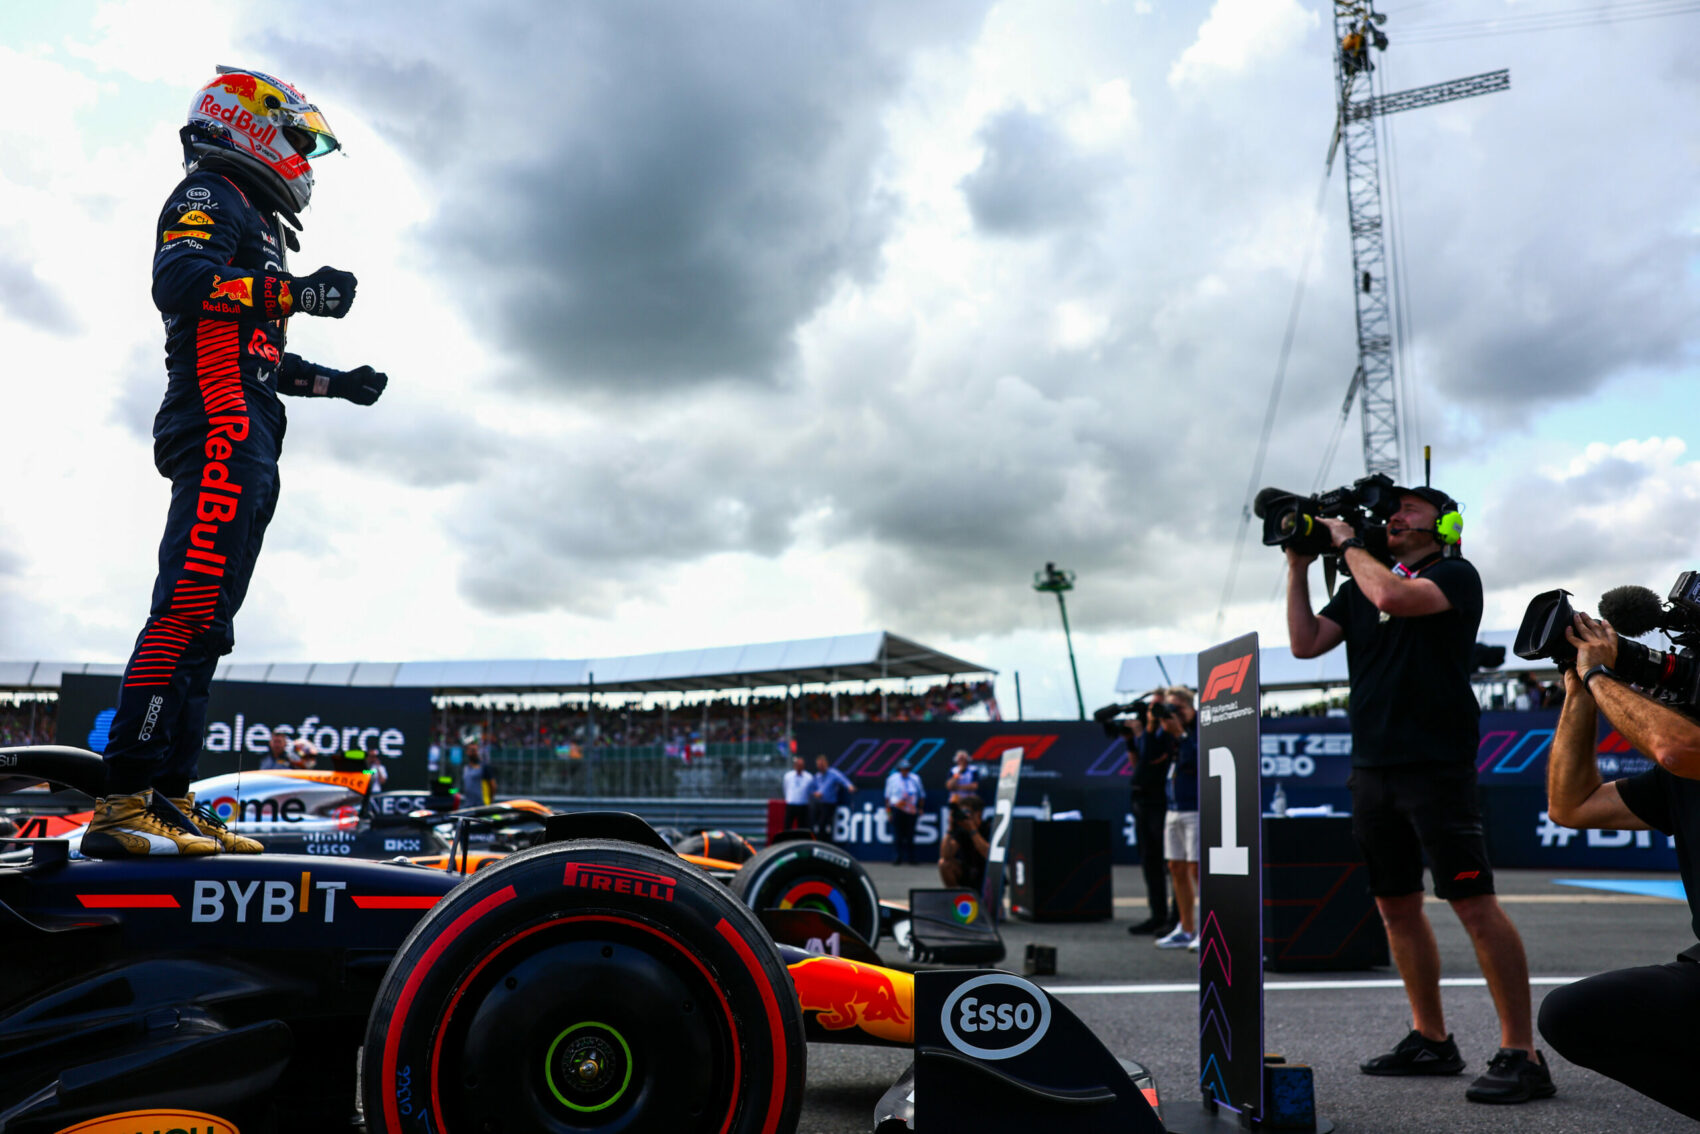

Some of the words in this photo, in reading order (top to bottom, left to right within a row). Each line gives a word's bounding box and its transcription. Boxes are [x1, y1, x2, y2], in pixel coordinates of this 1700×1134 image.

[204, 713, 405, 757] alesforce
[1261, 733, 1300, 755] ET
[1261, 755, 1315, 778] 030
[1209, 747, 1249, 875] 1
[191, 872, 346, 923] BYBIT
[563, 862, 677, 902] PIRELLI
[960, 997, 1035, 1033] Esso
